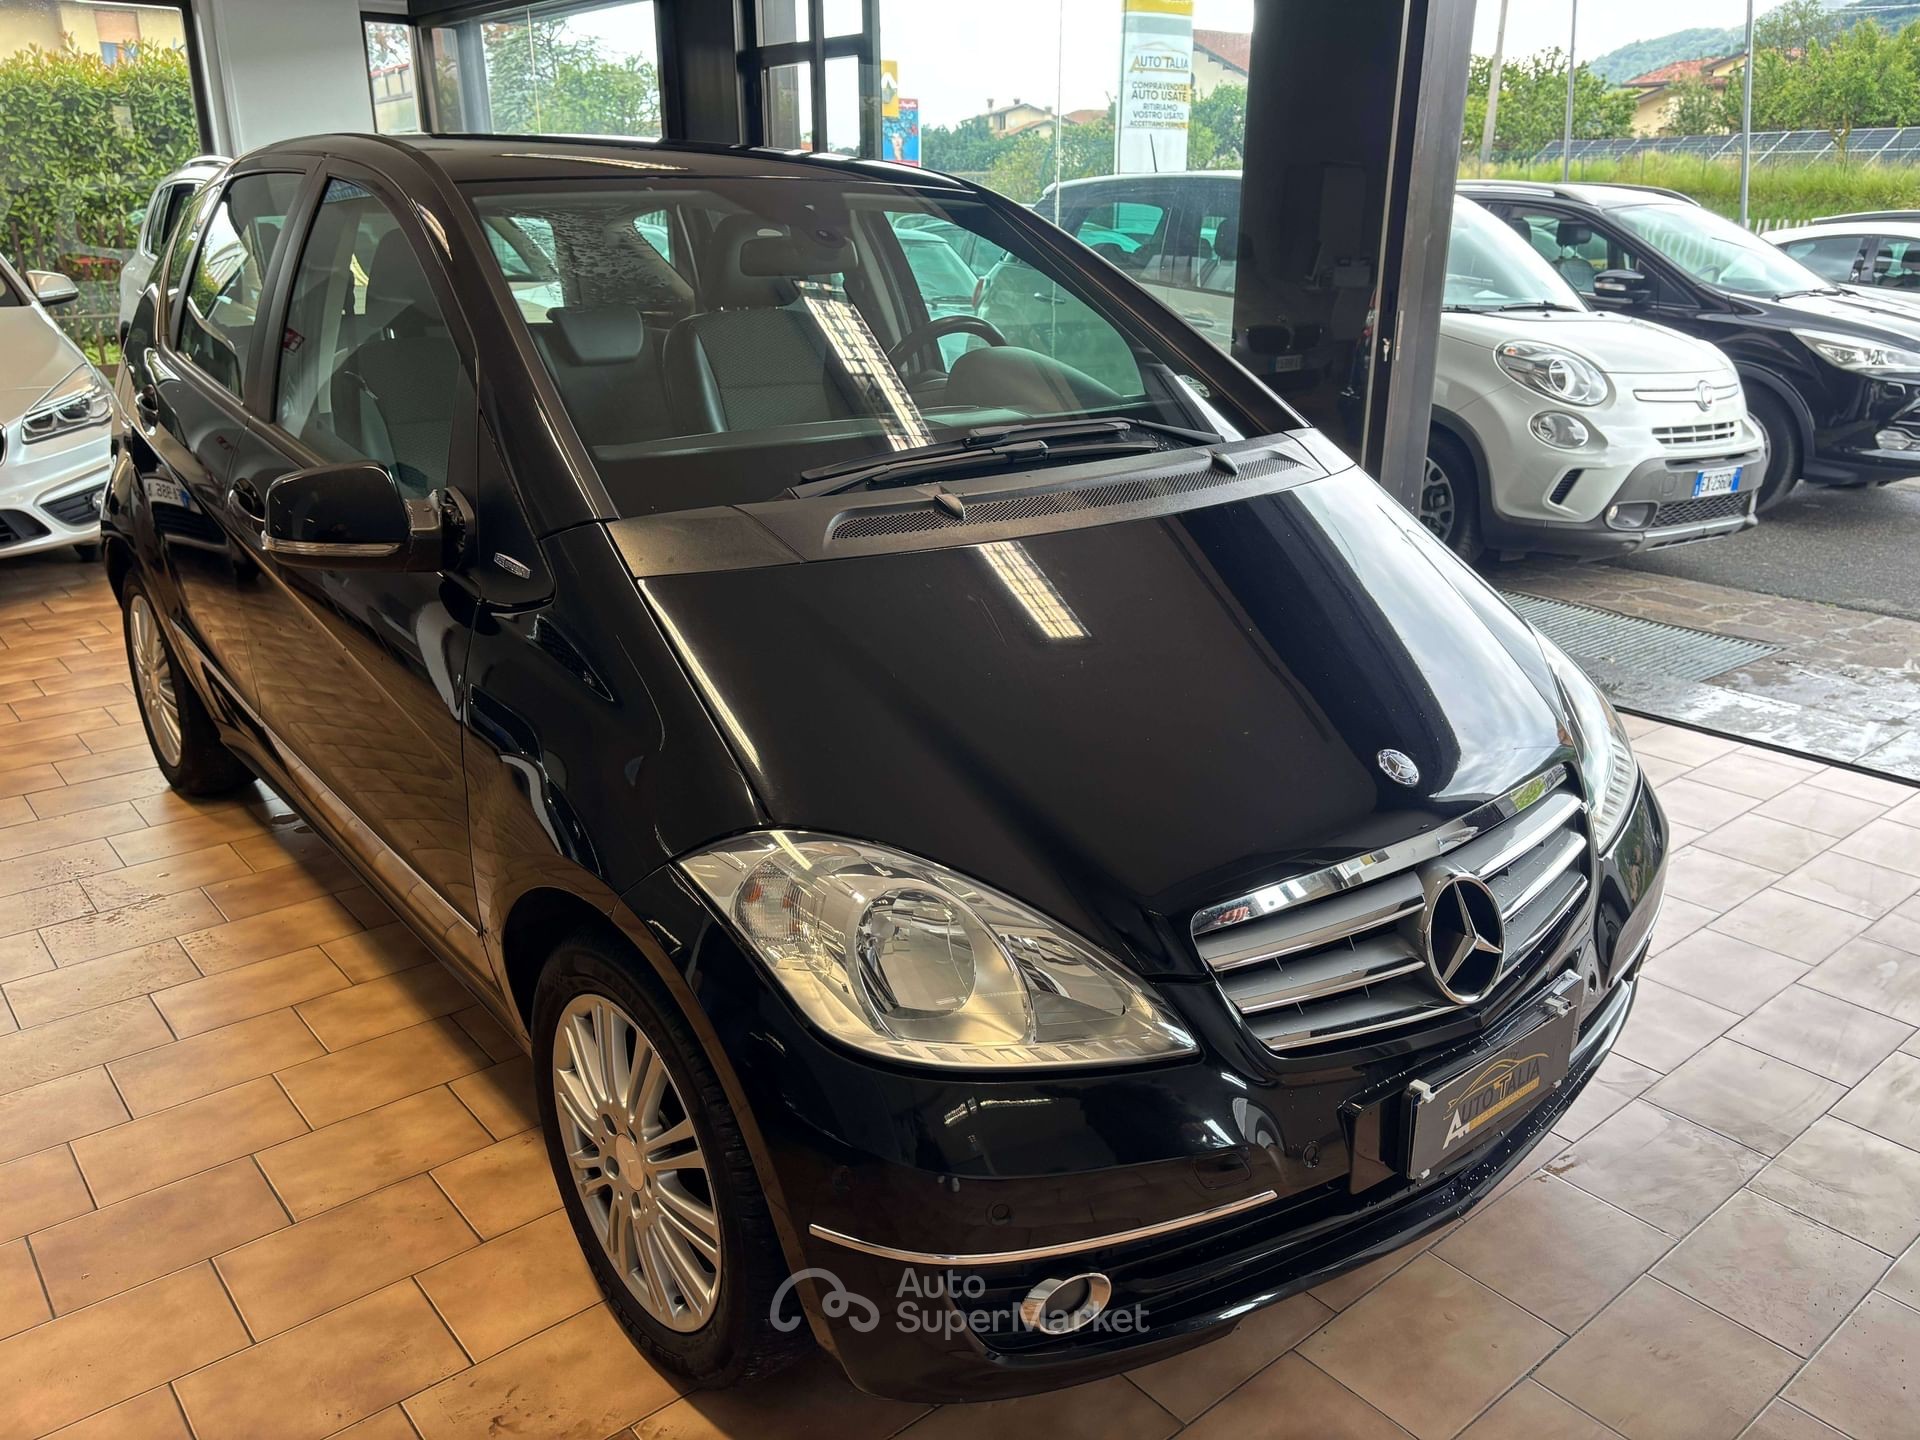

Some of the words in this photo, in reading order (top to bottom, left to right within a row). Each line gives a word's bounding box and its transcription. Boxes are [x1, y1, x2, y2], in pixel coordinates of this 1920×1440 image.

[1129, 56, 1161, 73] AUTO
[1131, 81, 1187, 91] COMPRAVENDITA
[1131, 90, 1159, 100] AUTO
[1161, 91, 1187, 102] USATE
[1142, 103, 1178, 112] RITIRIAMO
[1132, 111, 1162, 119] VOSTRO
[1163, 112, 1185, 120] USATO
[1442, 1088, 1494, 1150] AUTO
